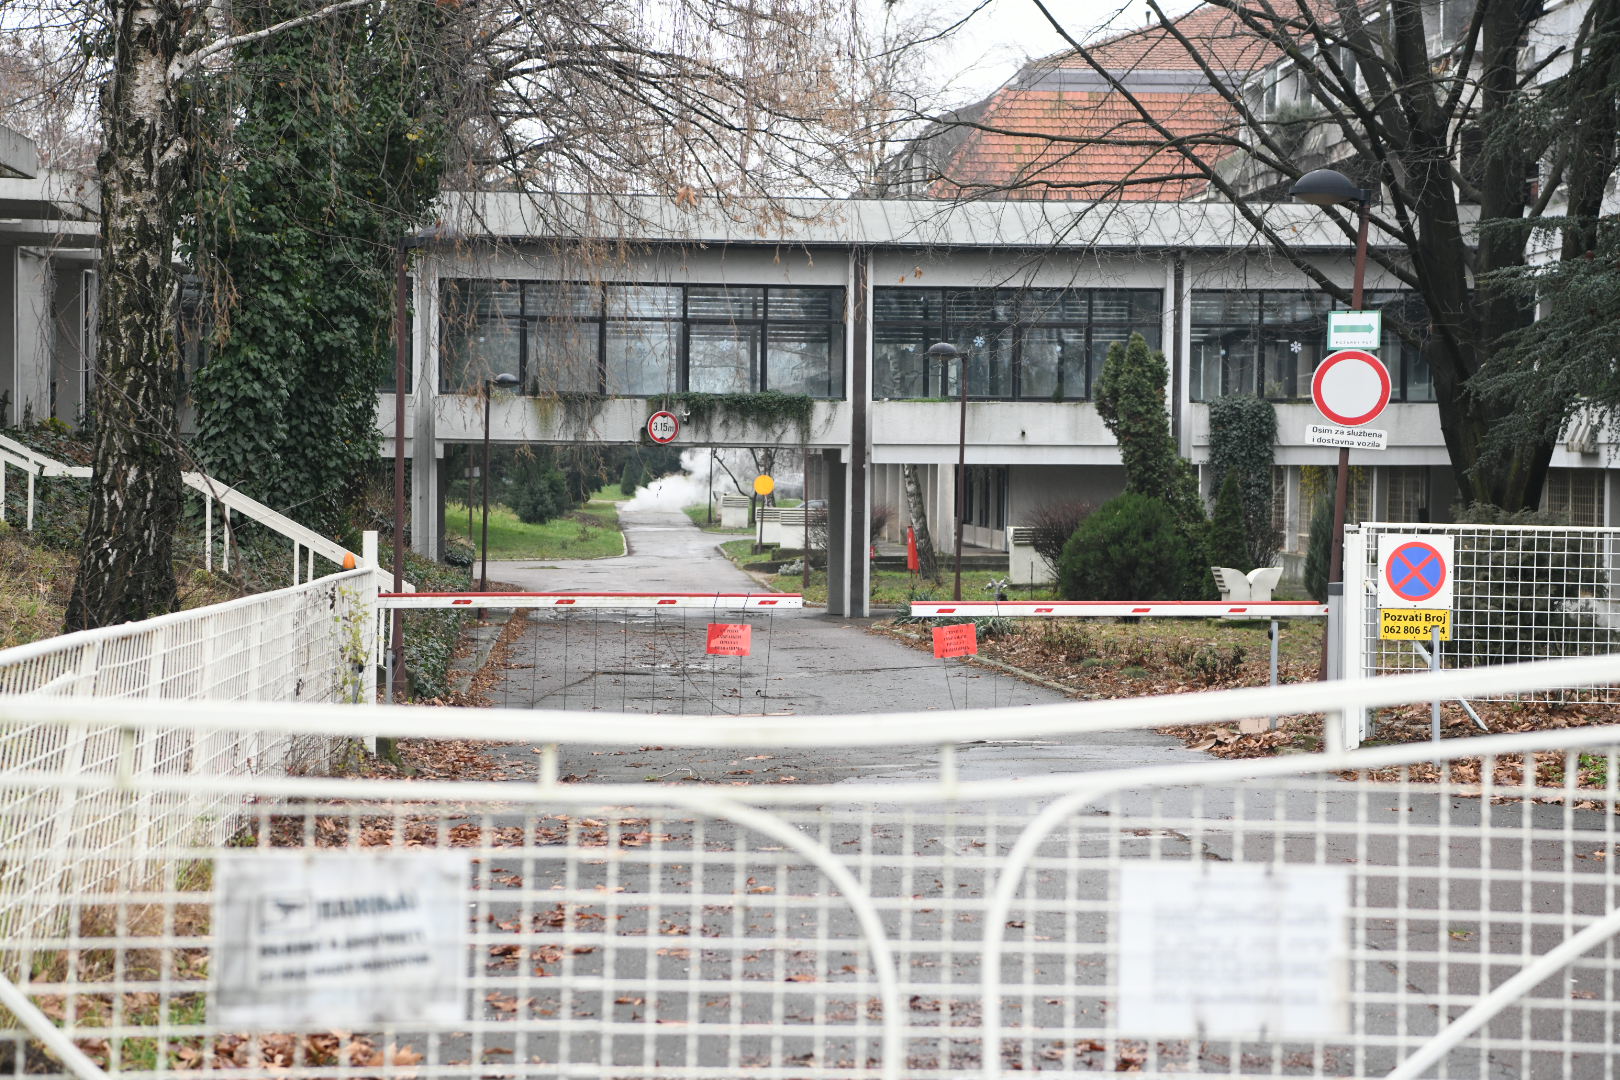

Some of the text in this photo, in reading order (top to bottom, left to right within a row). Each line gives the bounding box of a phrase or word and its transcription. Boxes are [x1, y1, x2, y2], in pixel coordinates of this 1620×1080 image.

[653, 422, 675, 432] 3.15m
[1312, 426, 1333, 434] Osim
[1317, 436, 1355, 446] dostavna
[1356, 440, 1381, 448] vozila
[1384, 612, 1446, 624] Pozvati Broj
[1384, 625, 1401, 634] 062
[1403, 625, 1421, 634] 806
